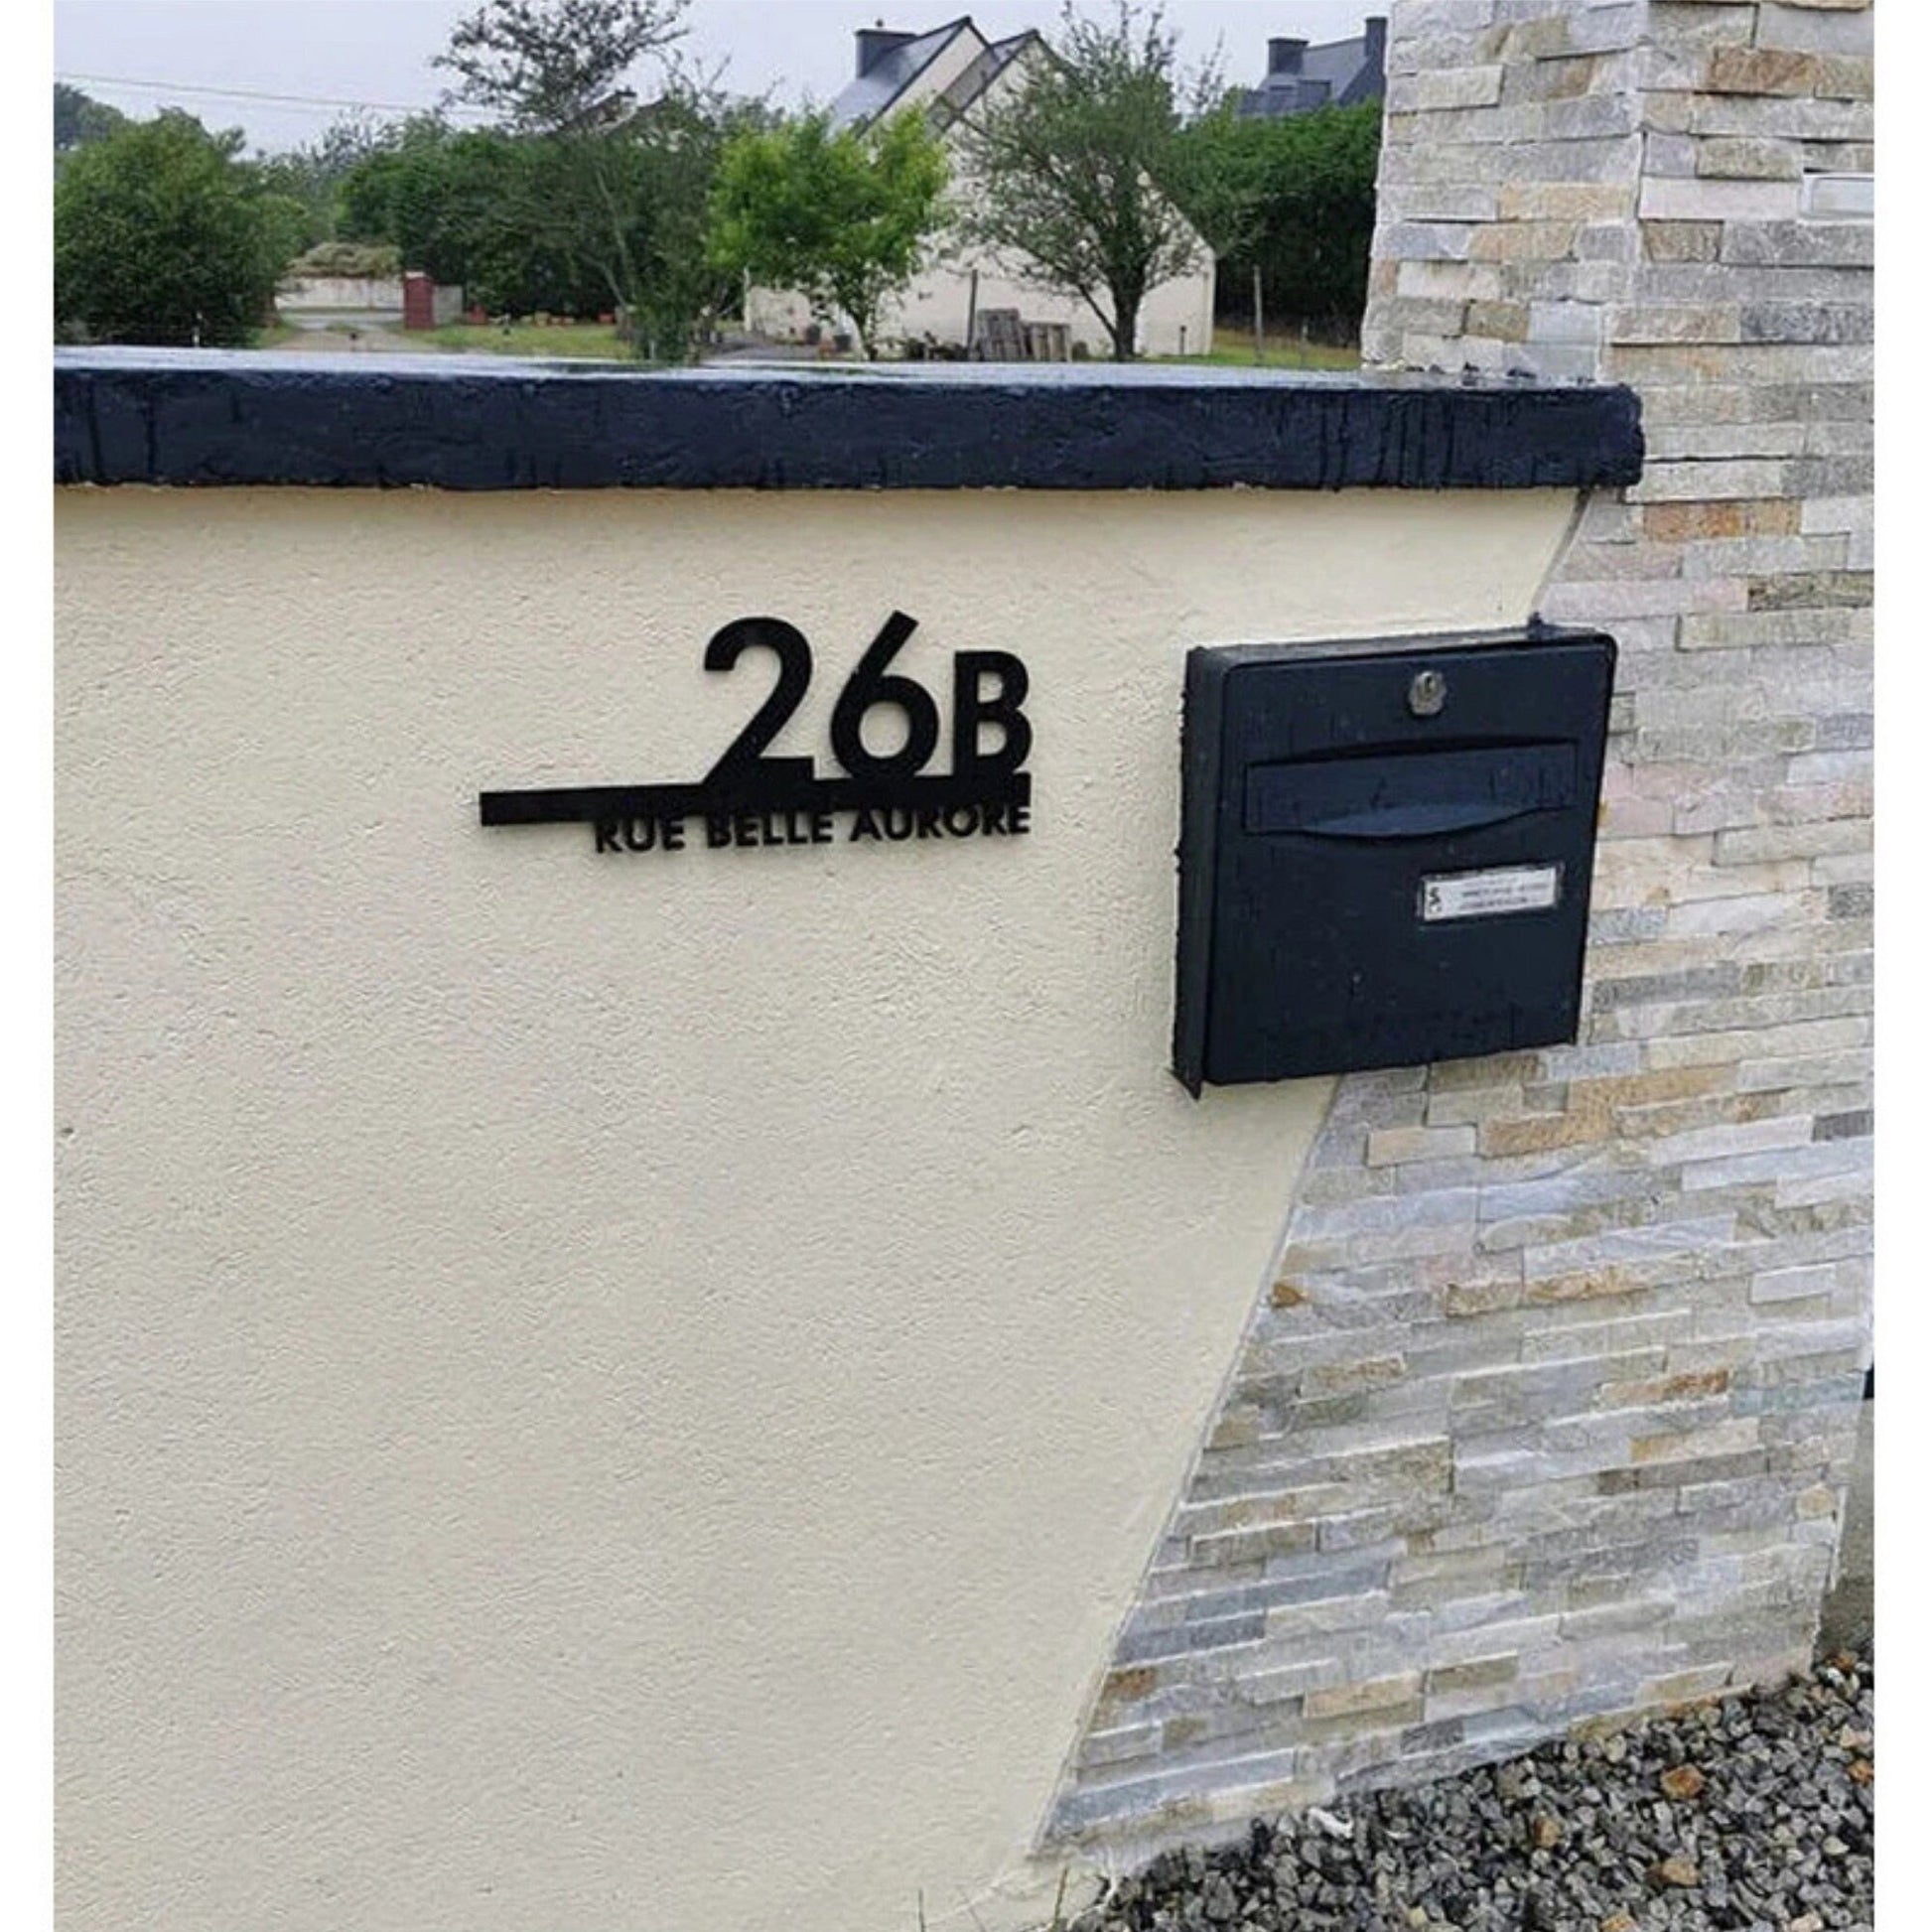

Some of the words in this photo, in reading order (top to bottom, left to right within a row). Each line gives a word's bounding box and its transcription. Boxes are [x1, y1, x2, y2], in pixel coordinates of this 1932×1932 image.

[703, 610, 1034, 784] 26B
[595, 813, 685, 854] RUE
[706, 809, 834, 849] BELLE
[849, 803, 1031, 843] AURORE
